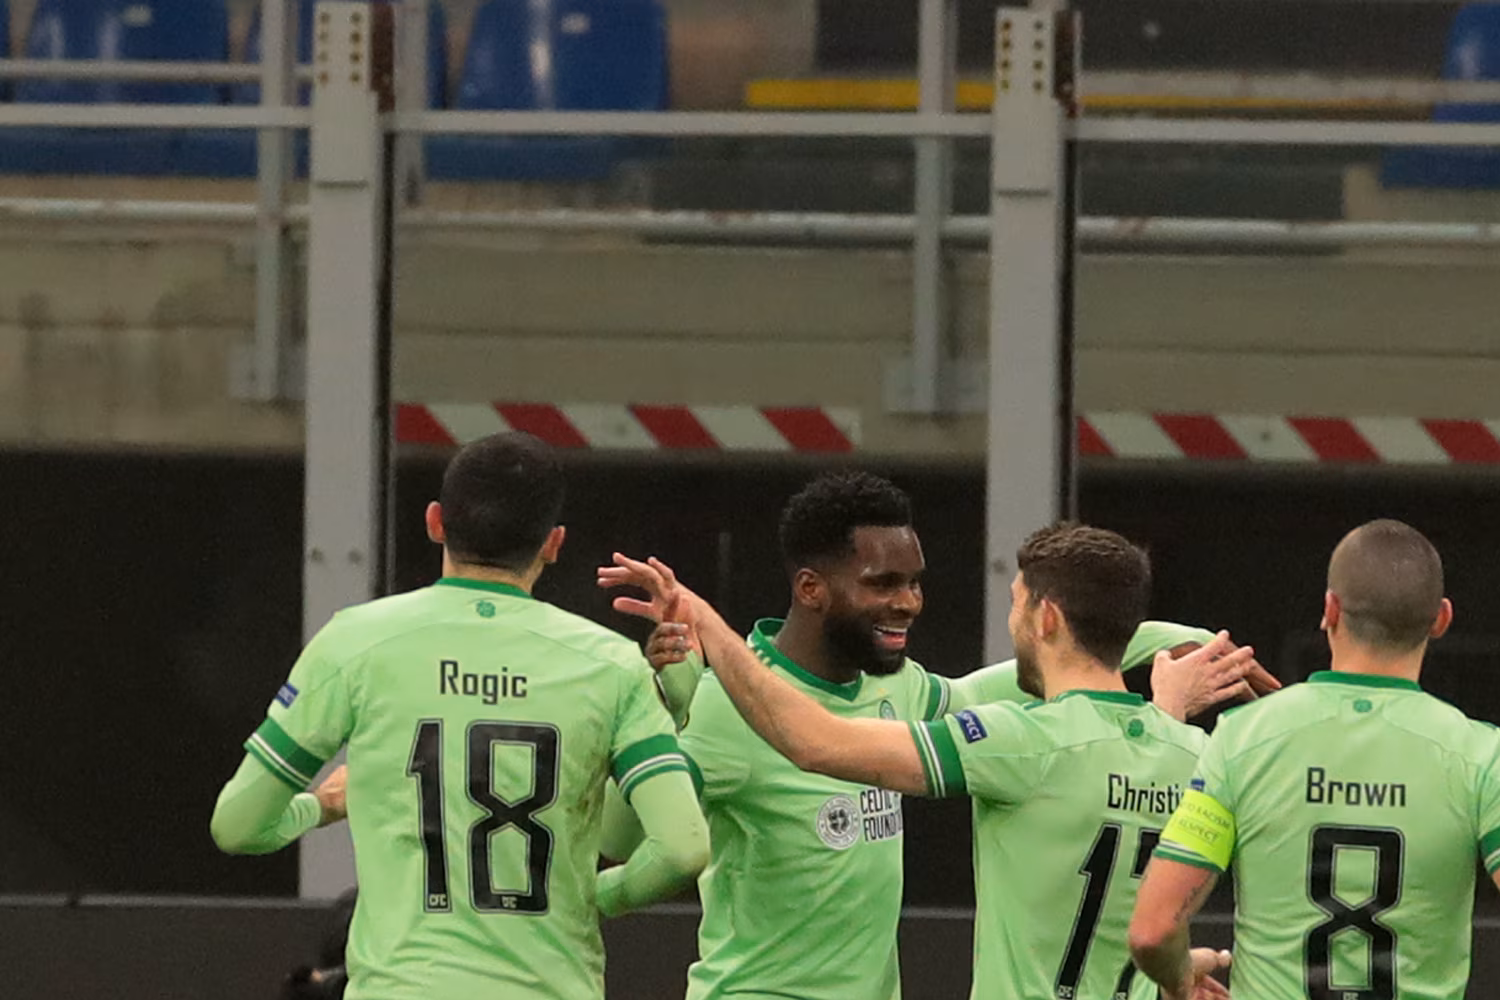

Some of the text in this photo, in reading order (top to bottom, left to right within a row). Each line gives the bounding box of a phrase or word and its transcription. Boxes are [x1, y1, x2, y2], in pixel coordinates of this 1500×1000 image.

[439, 660, 528, 705] Rogic
[1107, 772, 1184, 815] Christi
[1306, 767, 1406, 807] Brown
[406, 718, 561, 916] 18
